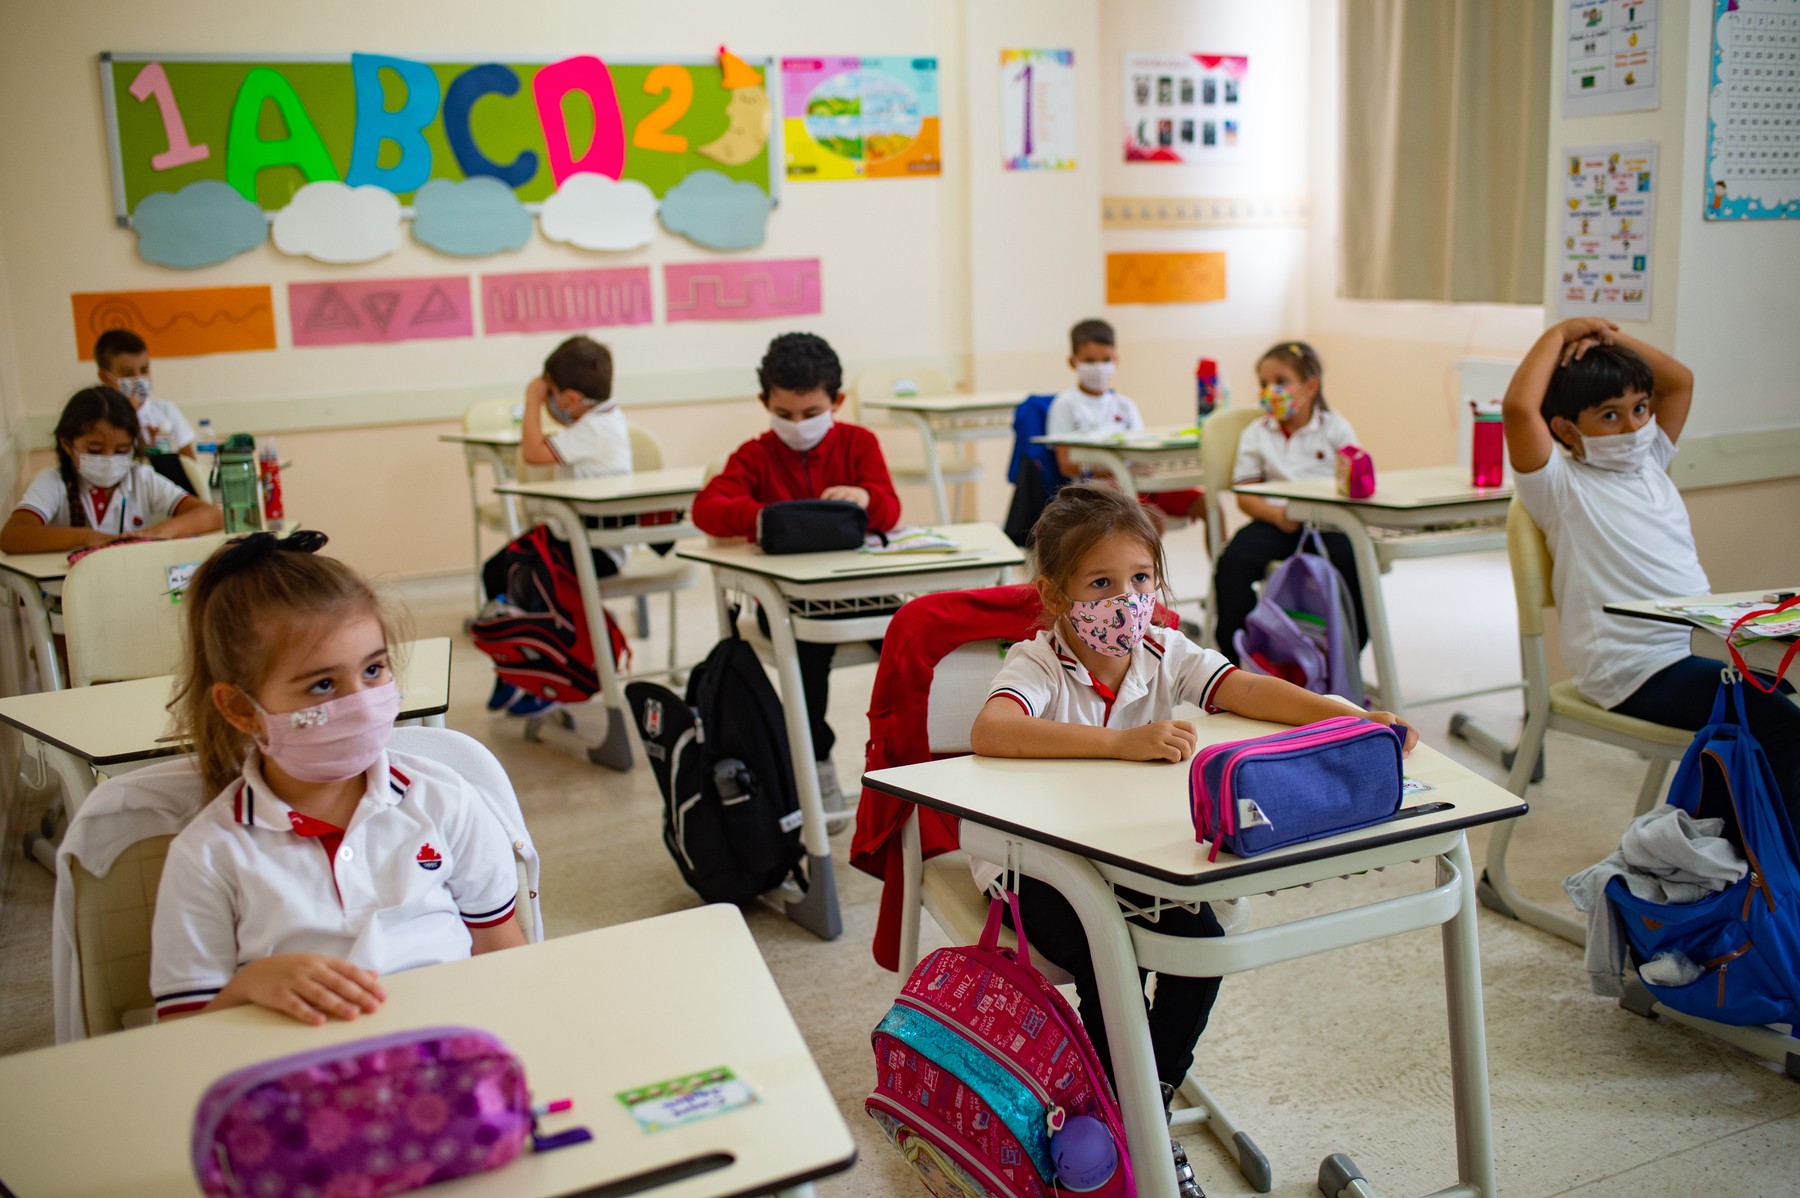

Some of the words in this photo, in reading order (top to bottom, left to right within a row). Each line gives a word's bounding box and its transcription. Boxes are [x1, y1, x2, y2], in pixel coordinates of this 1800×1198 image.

[129, 62, 210, 171] 1
[633, 64, 694, 154] 2
[953, 974, 974, 999] GIRLZ
